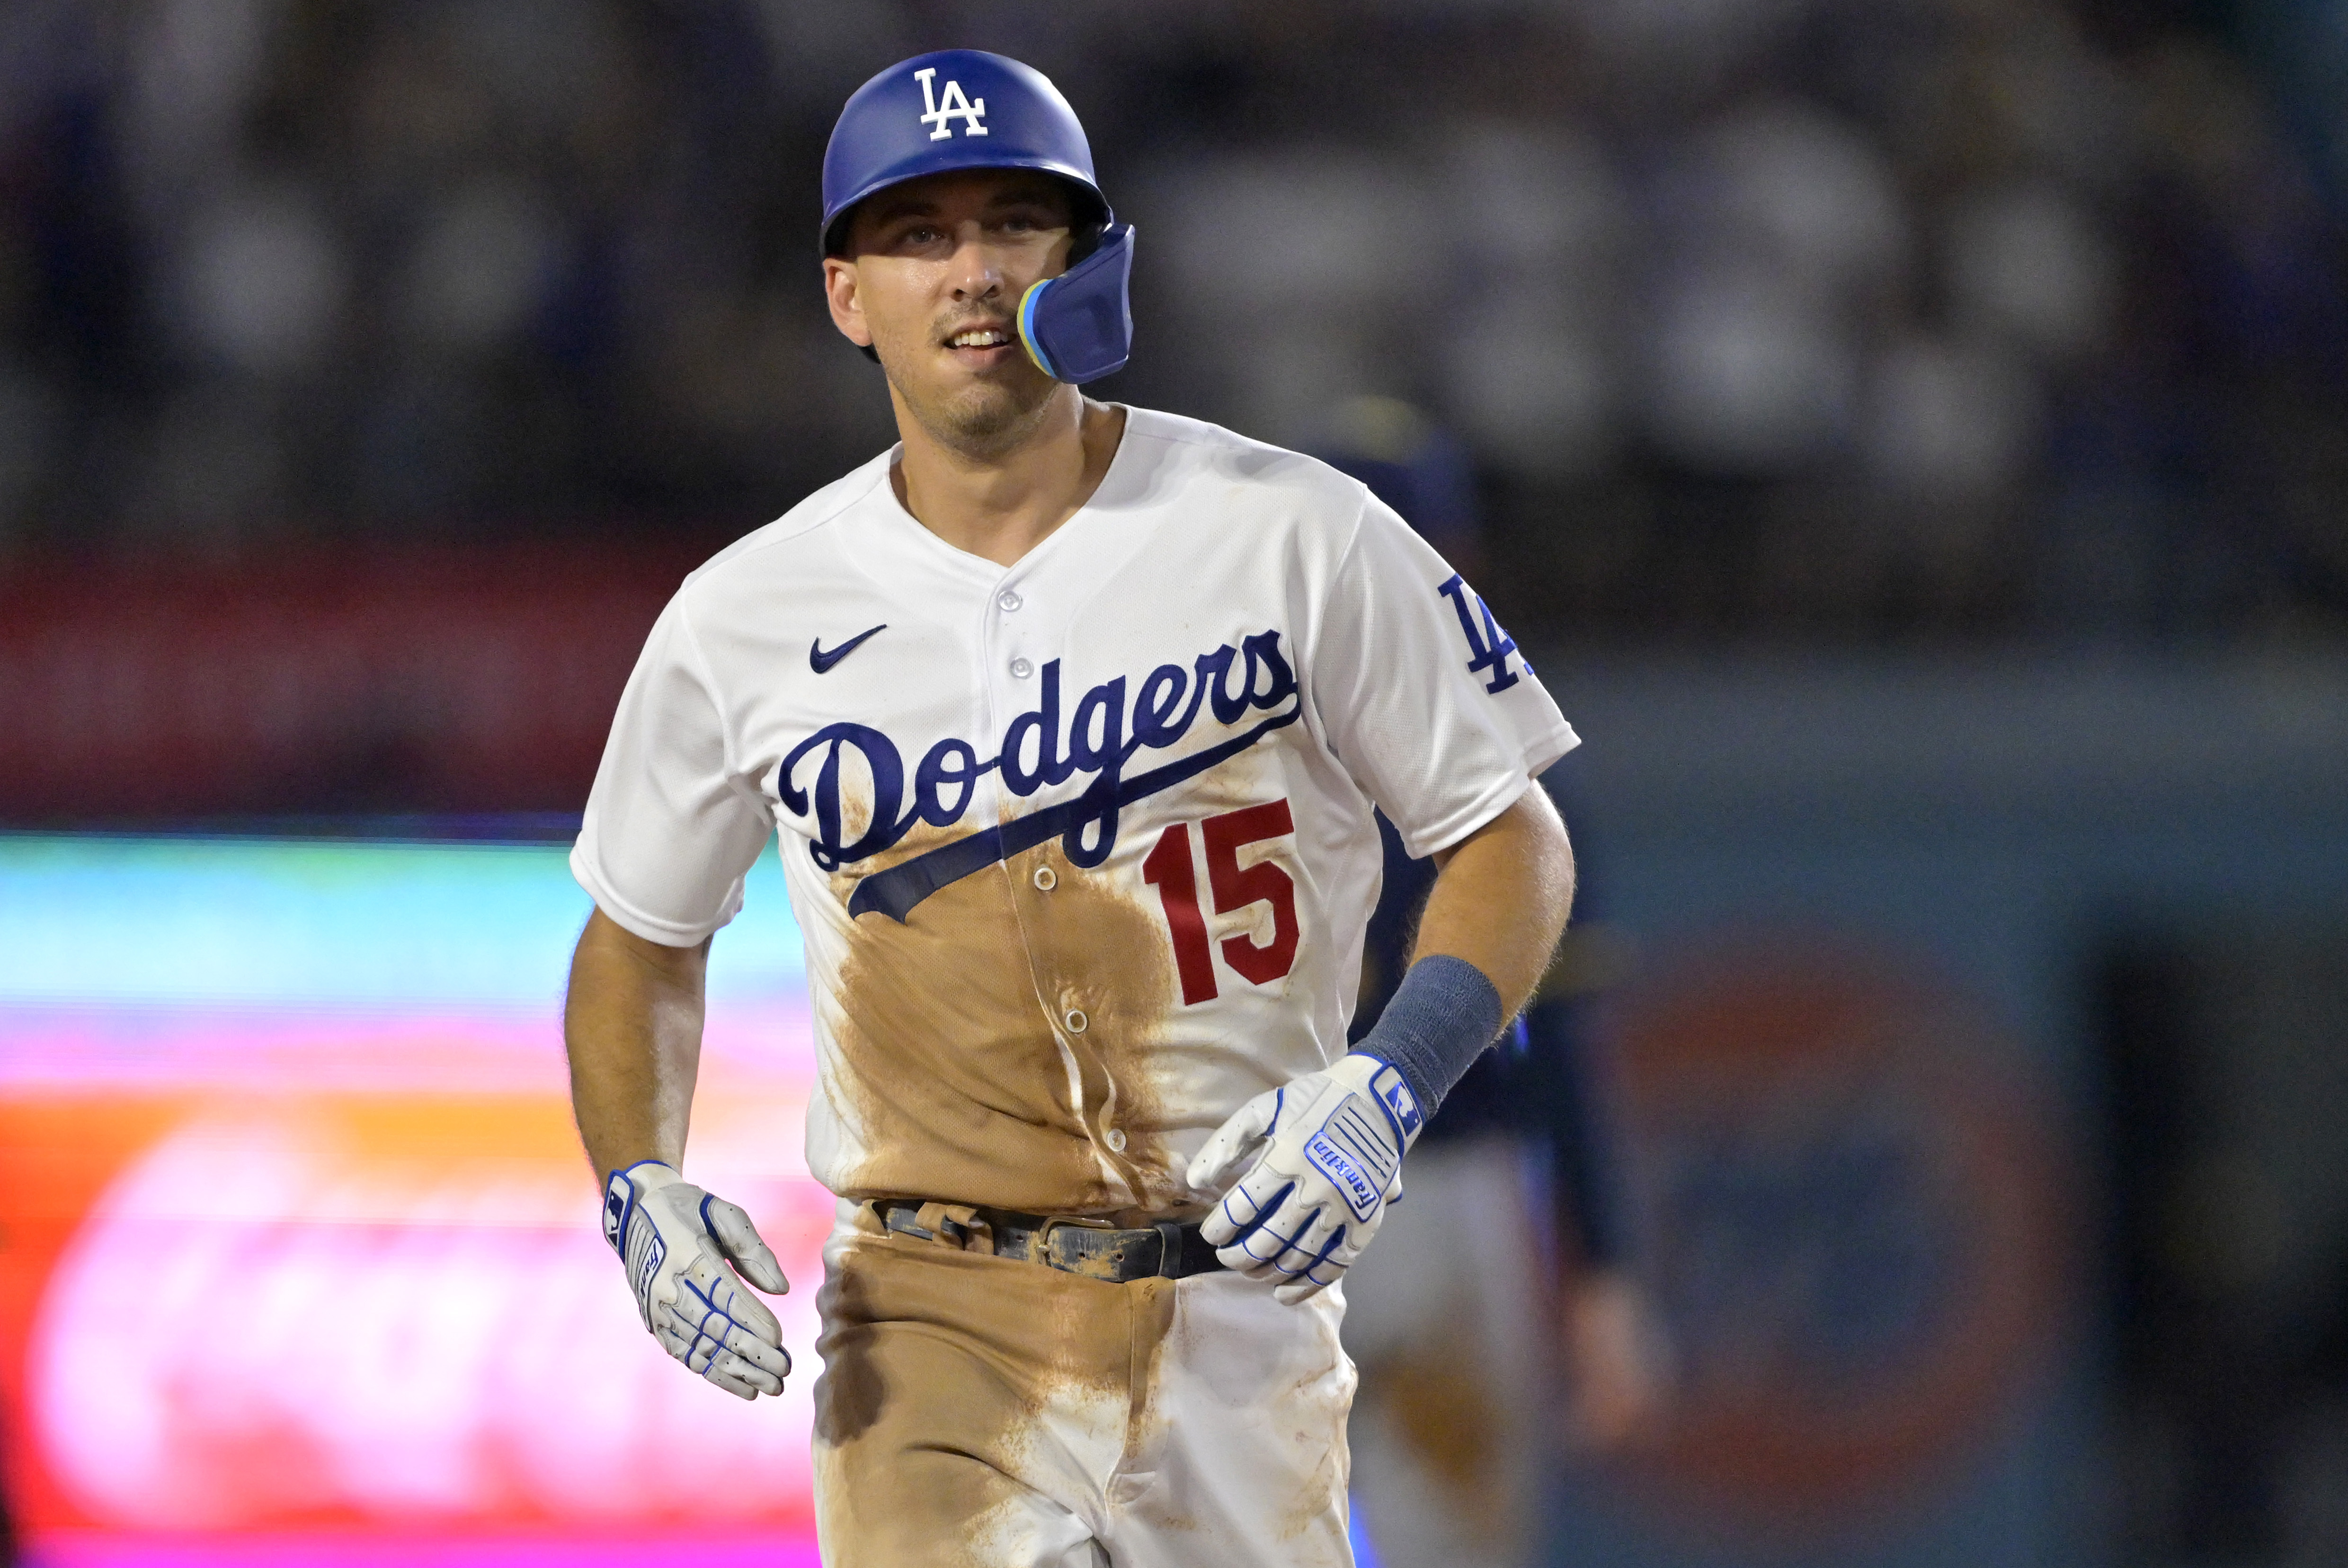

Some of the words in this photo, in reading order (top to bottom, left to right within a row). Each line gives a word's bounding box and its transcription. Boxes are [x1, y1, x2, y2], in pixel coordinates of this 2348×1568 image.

[914, 67, 988, 142] LA
[1437, 573, 1535, 694] LA
[779, 629, 1301, 872] Dodgers
[1143, 798, 1300, 1006] 15
[1314, 1141, 1377, 1209] Franklin
